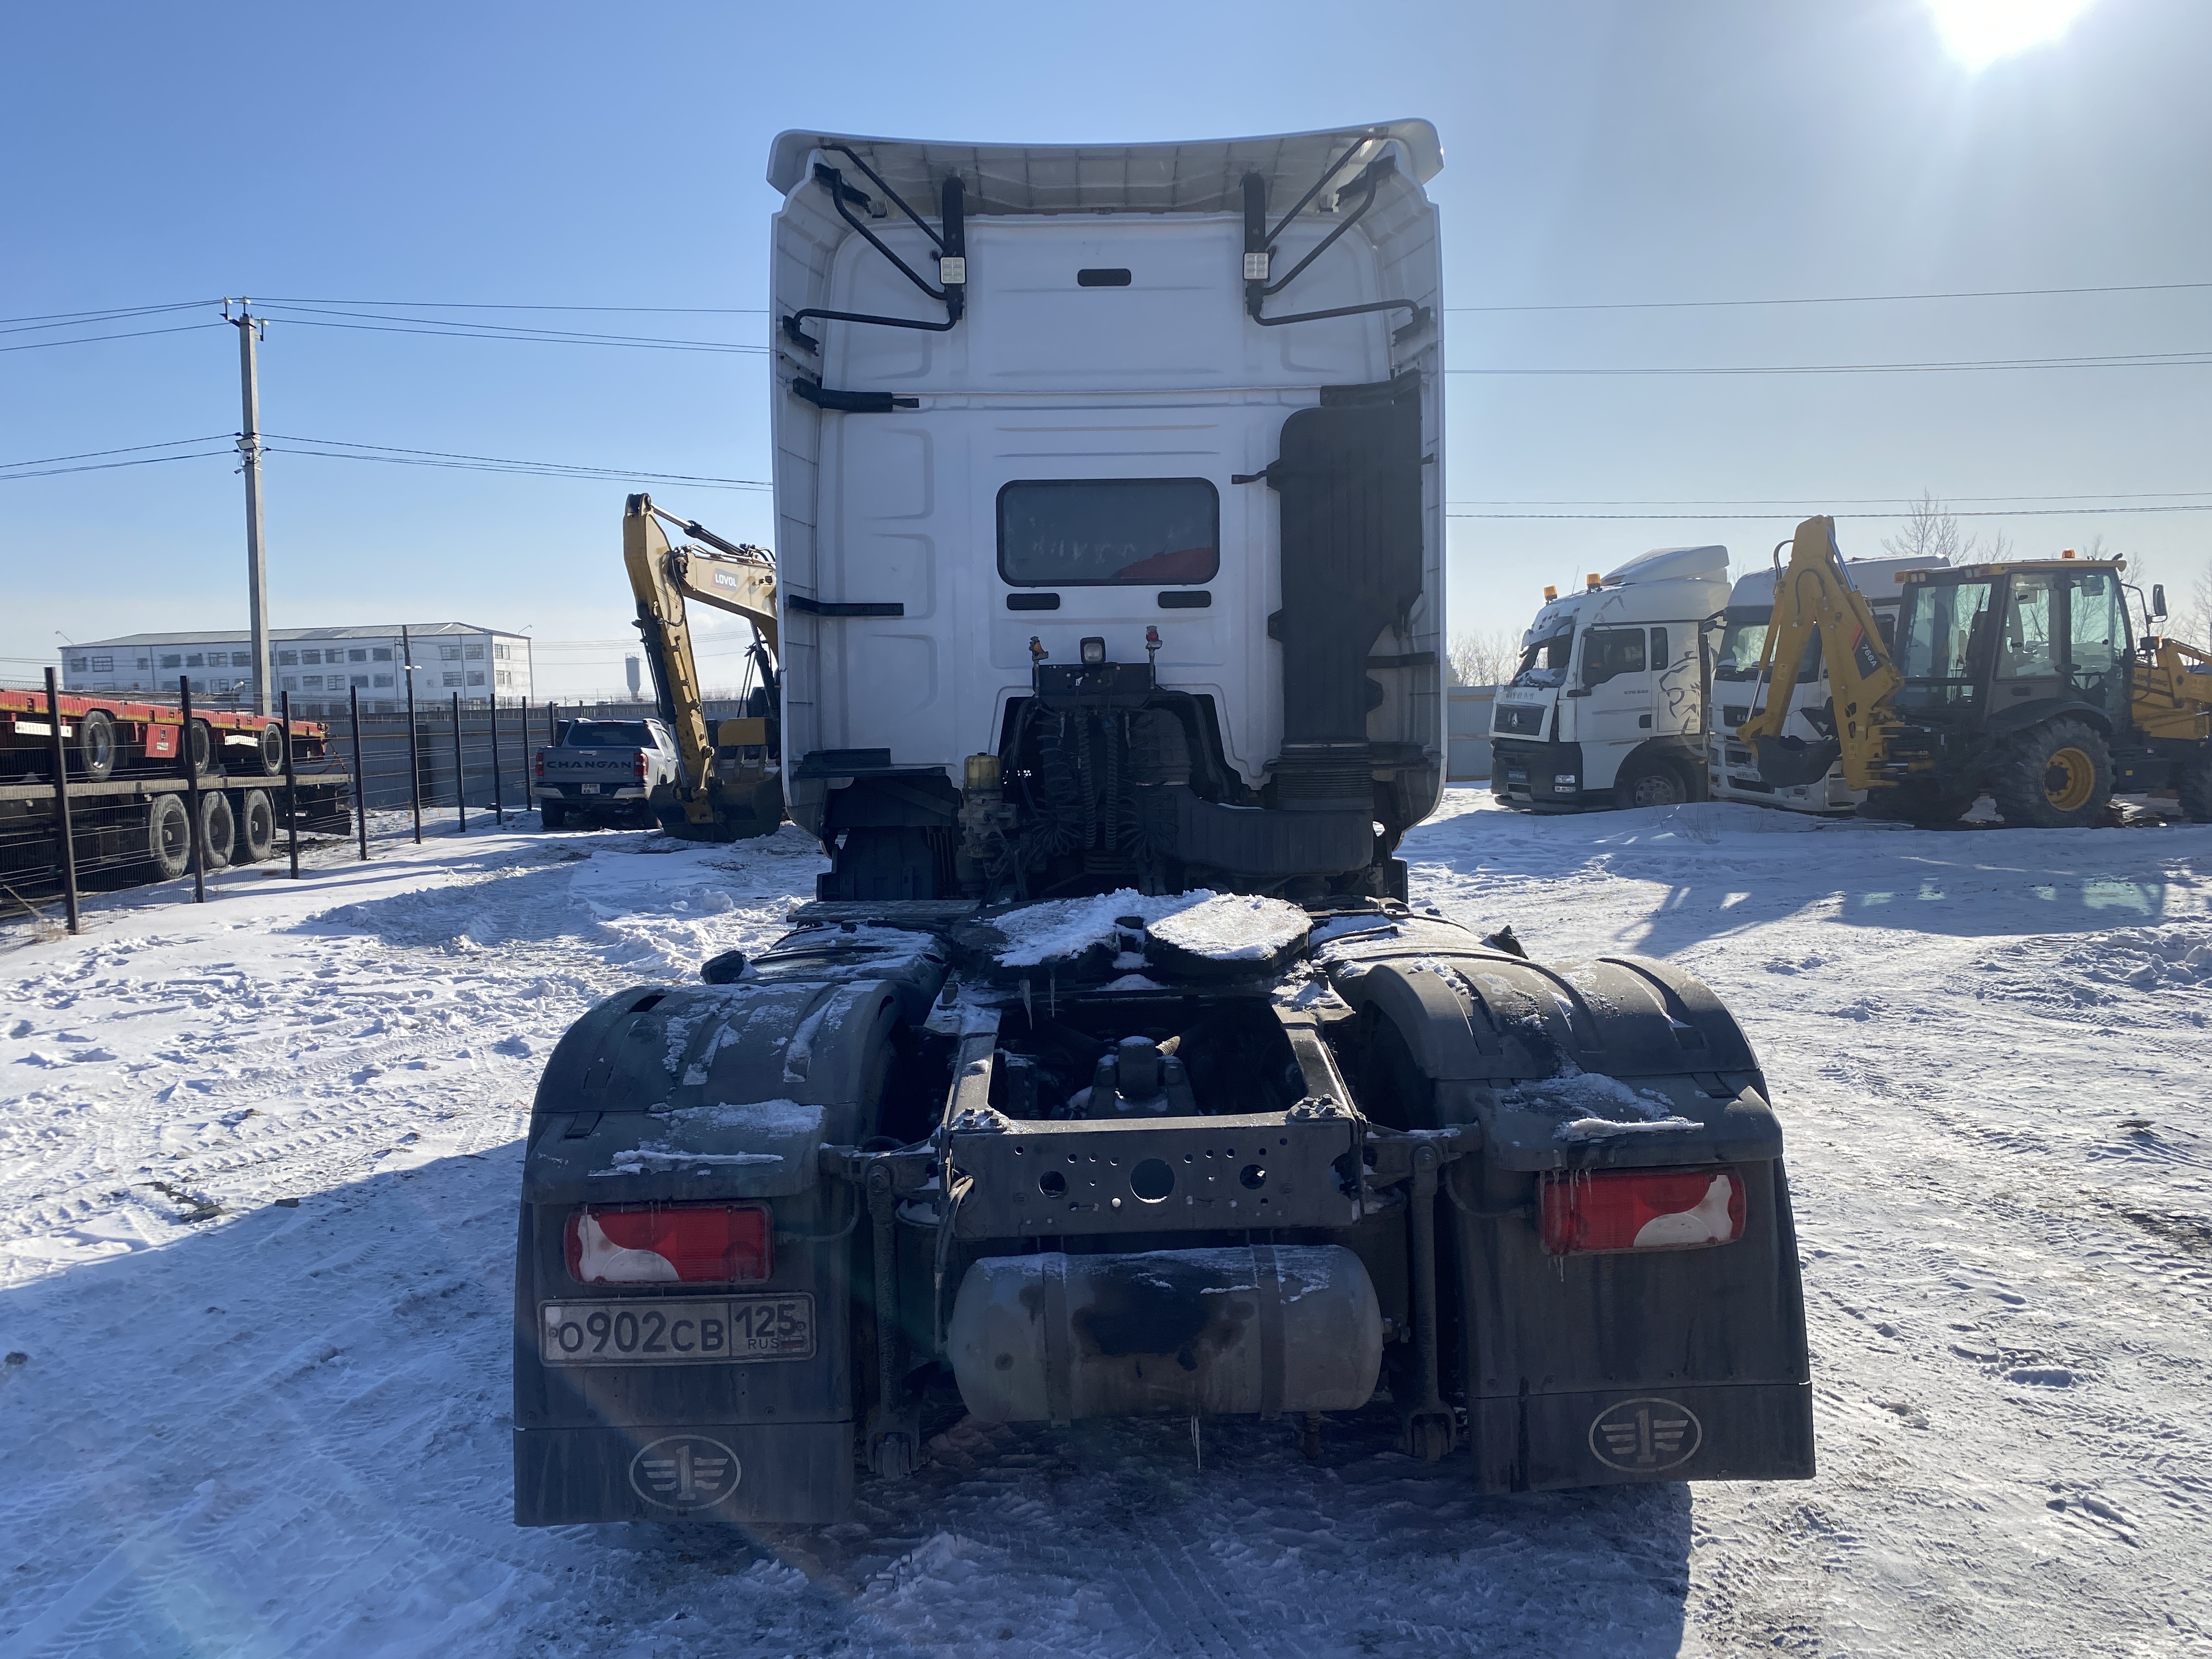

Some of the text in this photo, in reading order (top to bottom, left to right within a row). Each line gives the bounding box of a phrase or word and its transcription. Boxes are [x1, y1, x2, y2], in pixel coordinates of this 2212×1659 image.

[715, 573, 737, 587] LOVOL
[1862, 644, 1877, 668] 766A
[735, 1304, 796, 1339] 125
[747, 1338, 780, 1350] RUS
